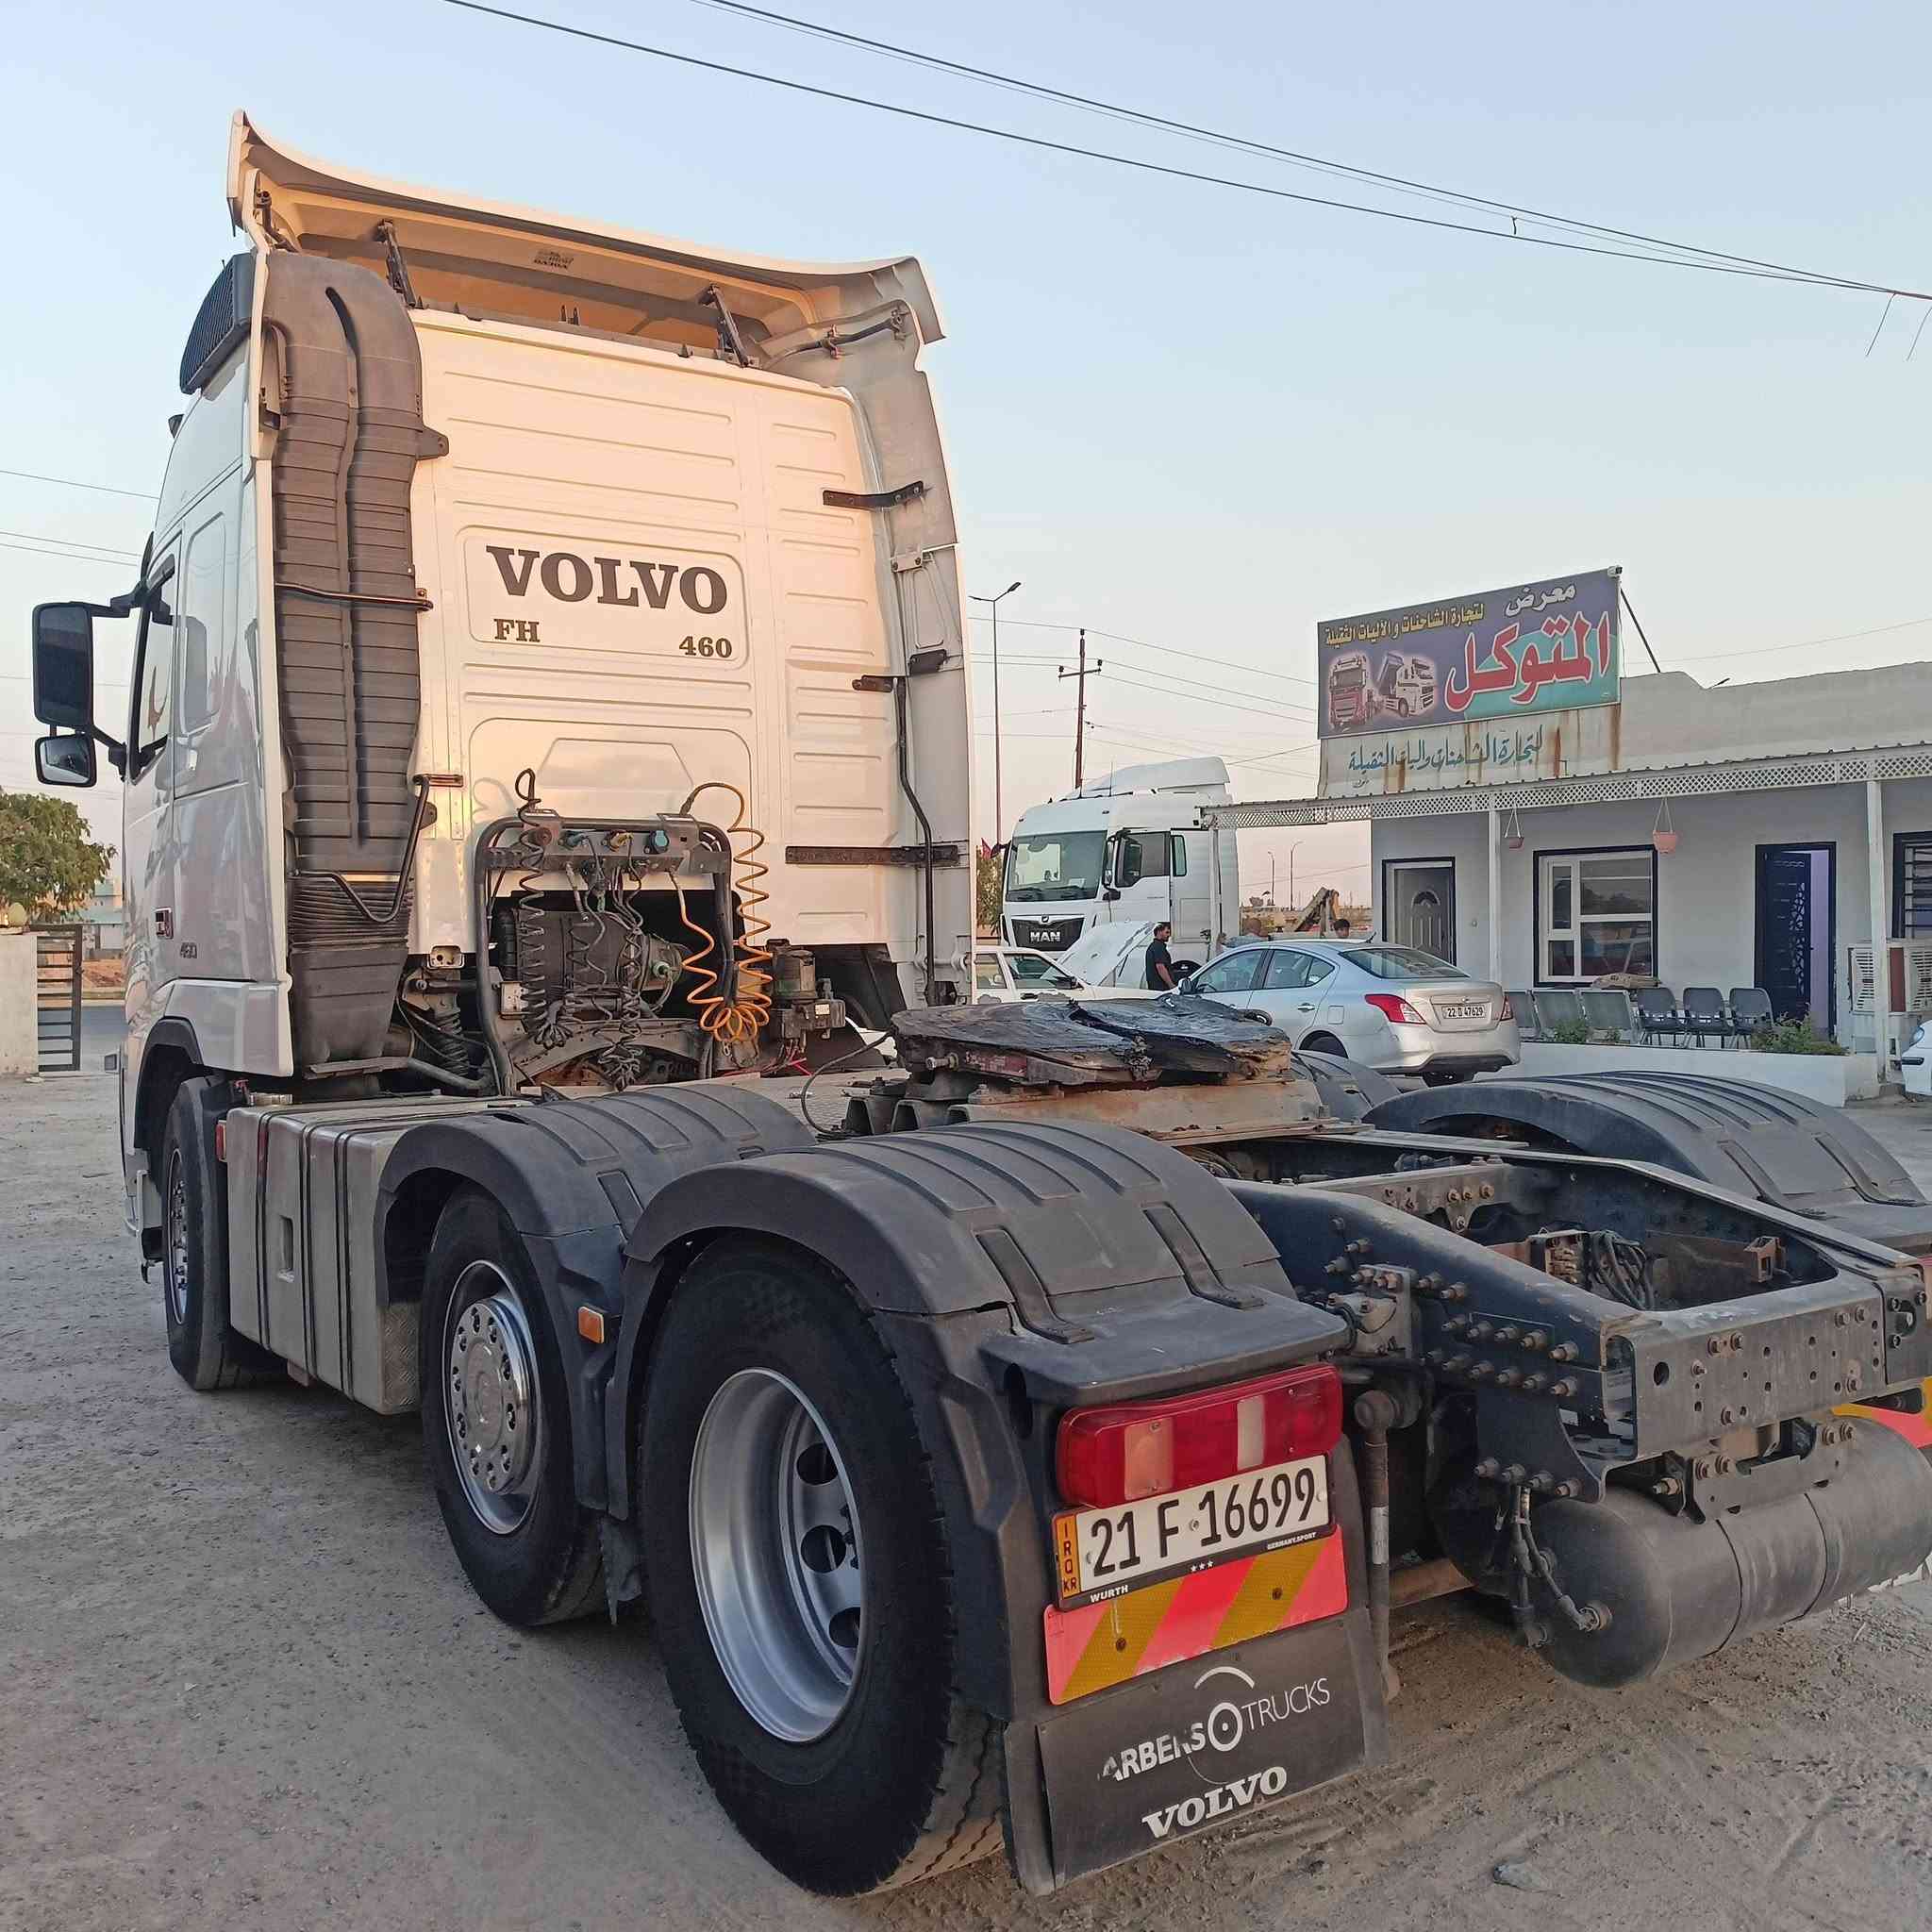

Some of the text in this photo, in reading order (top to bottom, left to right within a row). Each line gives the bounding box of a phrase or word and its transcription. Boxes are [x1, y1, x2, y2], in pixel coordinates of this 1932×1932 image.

[486, 545, 727, 615] VOLVO
[1504, 584, 1576, 617] معرض
[1402, 608, 1449, 633] الشاحنات
[1451, 603, 1485, 627] لتجارة
[493, 618, 541, 642] FH
[678, 636, 733, 658] 460
[1443, 610, 1610, 711] المتوكل
[1030, 930, 1061, 942] MAN
[1447, 1008, 1457, 1017] 22
[1090, 1467, 1316, 1577] 21 F 16699
[1063, 1576, 1077, 1592] KR
[1241, 1677, 1331, 1730] TRUCKS
[1141, 1765, 1288, 1839] VOLVO
